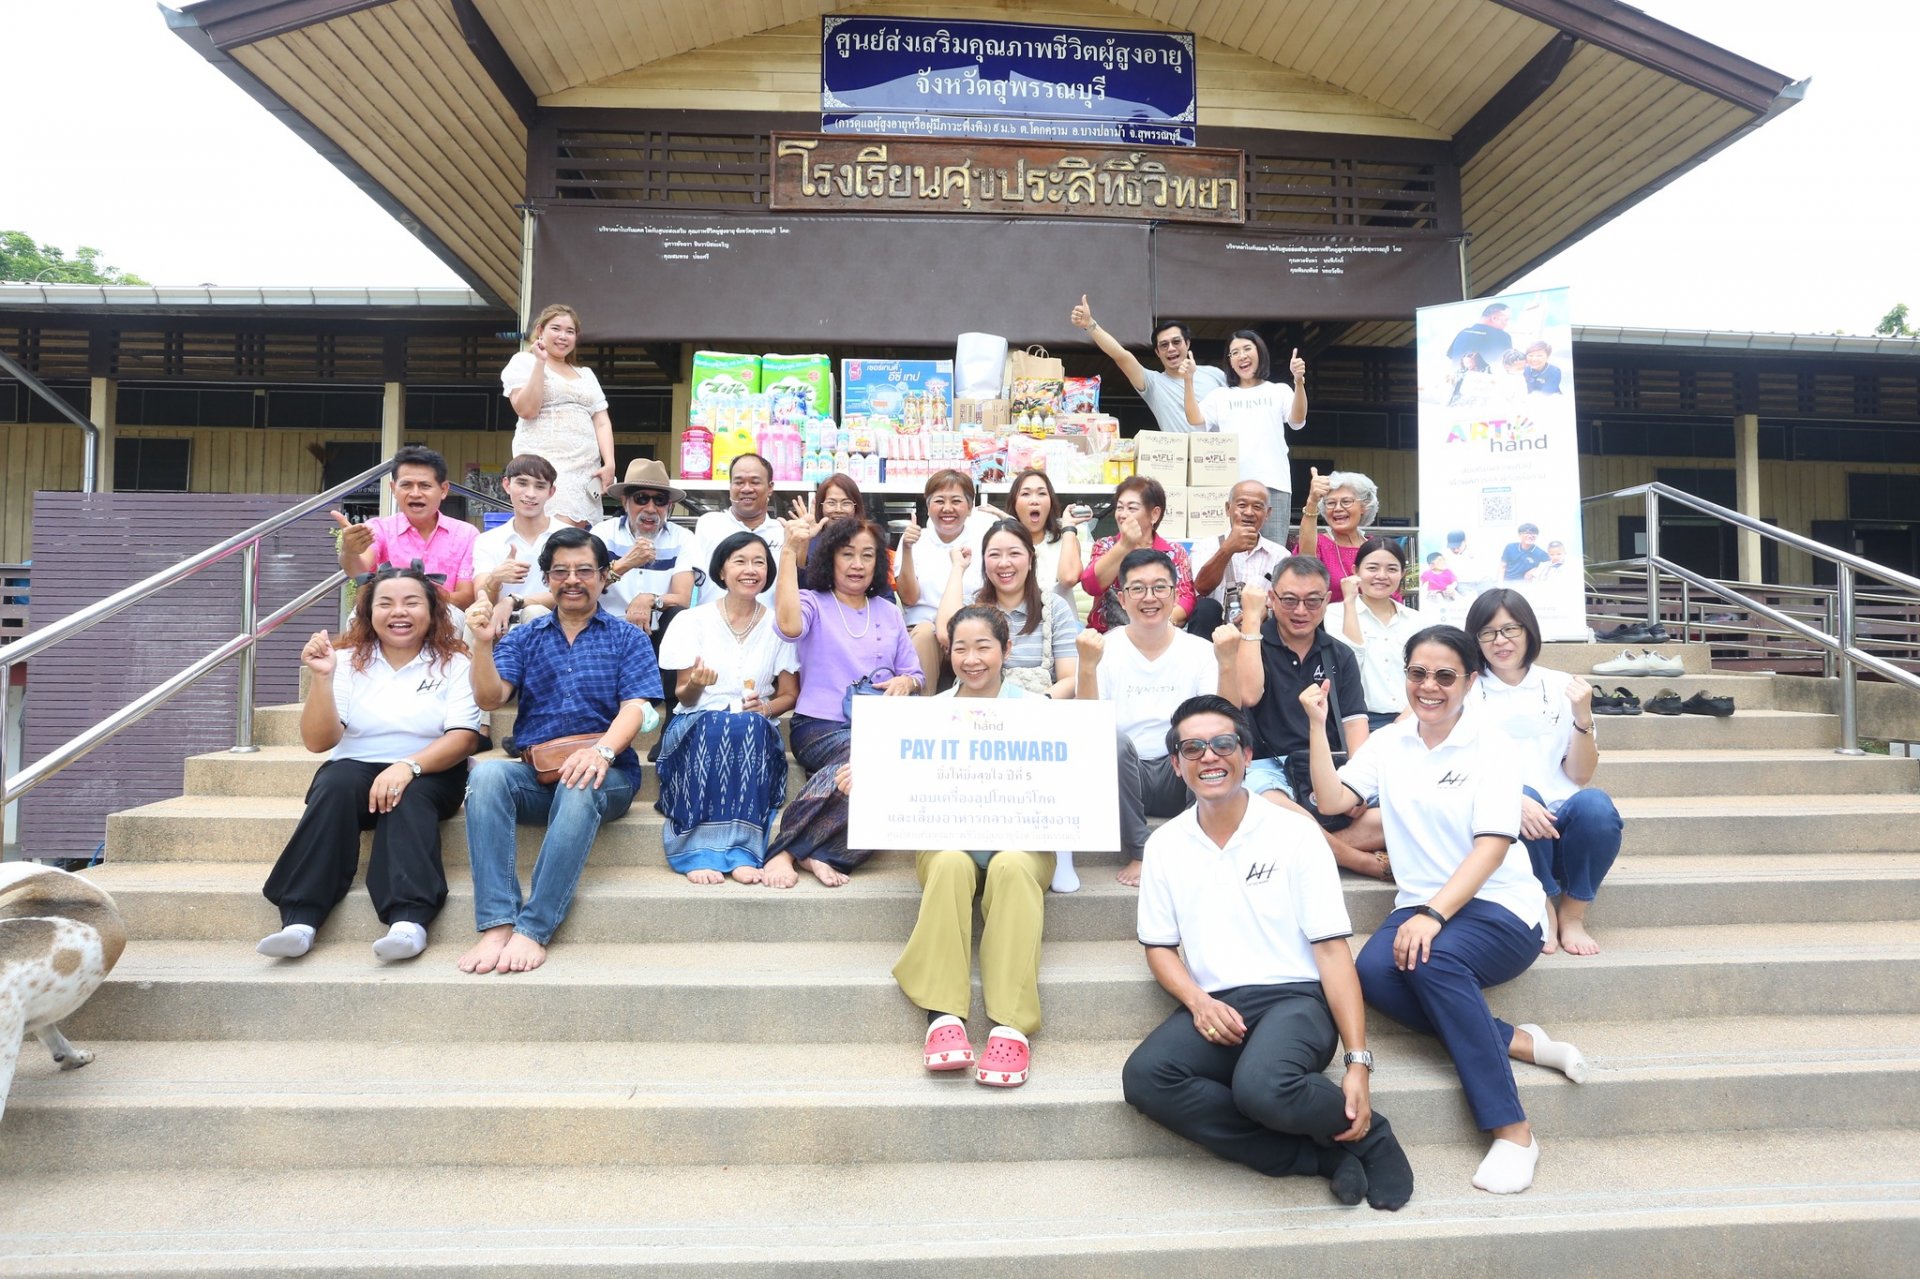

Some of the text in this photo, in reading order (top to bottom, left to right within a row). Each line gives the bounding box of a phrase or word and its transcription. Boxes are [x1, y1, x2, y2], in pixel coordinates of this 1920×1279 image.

[835, 27, 1183, 74] ศูนย์ส่งเสริมคุณภาพชีวิตผู้สูงอายุ
[915, 66, 1107, 108] จังหวัดสุพรรณบุรี
[1129, 129, 1181, 144] จ.สุพรรณบุรี
[1446, 419, 1507, 443] ART
[1490, 434, 1548, 453] hand
[900, 739, 1068, 762] PAY IT FORWARD
[1025, 772, 1033, 781] 5
